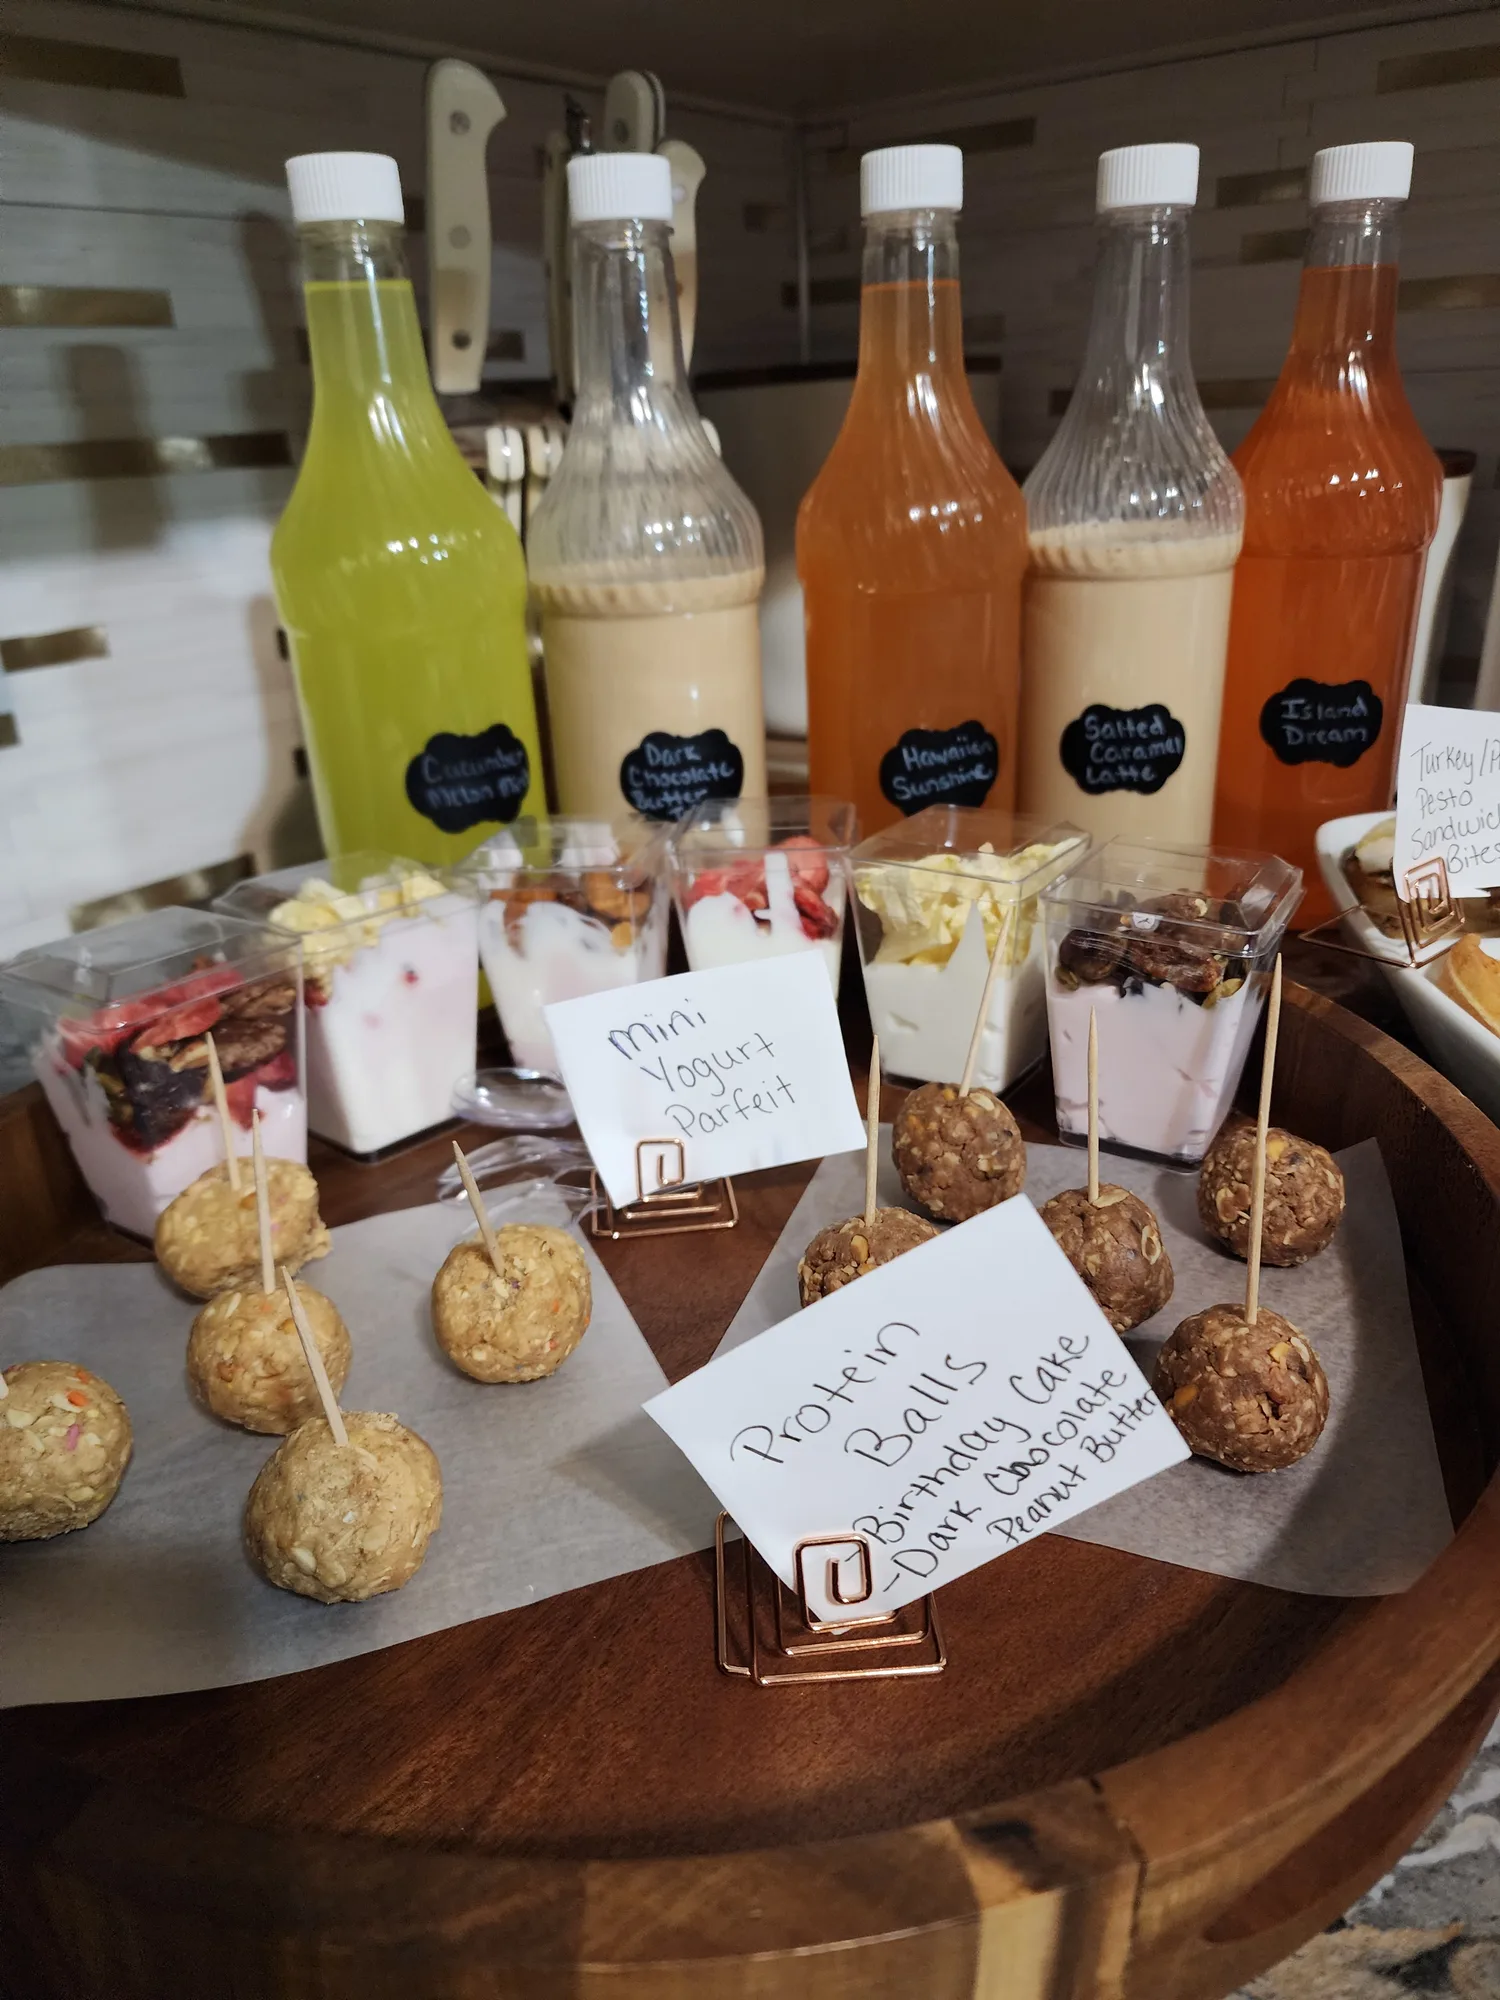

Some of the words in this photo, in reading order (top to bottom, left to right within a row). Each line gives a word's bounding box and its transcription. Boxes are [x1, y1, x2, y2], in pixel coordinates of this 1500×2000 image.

[1084, 713, 1165, 741] Salted
[1281, 695, 1367, 720] Island
[1281, 725, 1367, 745] Dream
[644, 743, 701, 766] Dark
[1086, 764, 1158, 785] Latte
[1416, 787, 1472, 819] Pesto
[1411, 805, 1500, 860] Sandwic
[640, 1033, 774, 1097] Yogurt
[665, 1075, 795, 1137] Parfeit
[730, 1322, 920, 1463] Protein
[1009, 1335, 1089, 1404] Cake
[845, 1354, 987, 1467] Balls
[986, 1463, 1087, 1543] Peanut
[1081, 1390, 1158, 1463] Butter
